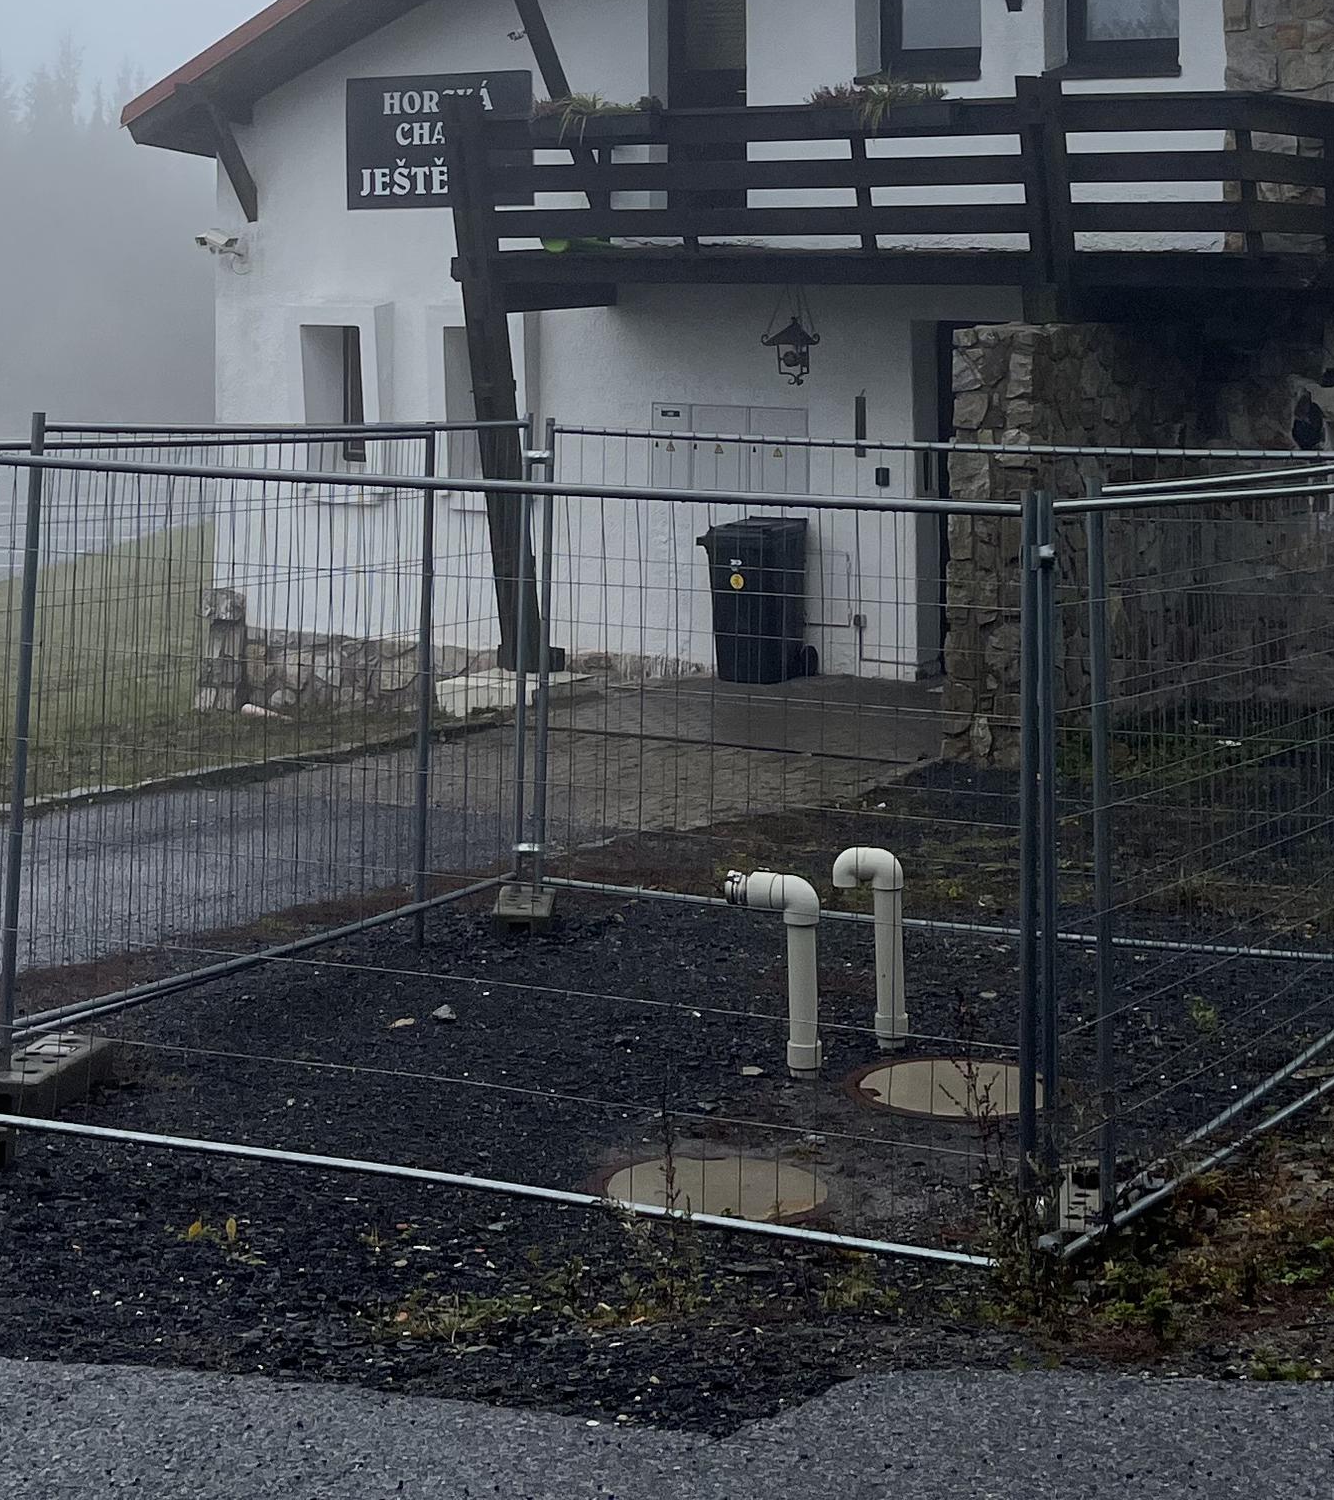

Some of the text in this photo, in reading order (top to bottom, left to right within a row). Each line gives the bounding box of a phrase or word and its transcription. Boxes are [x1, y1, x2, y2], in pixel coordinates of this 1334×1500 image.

[382, 80, 493, 114] HORÁ
[395, 121, 445, 146] CHA
[361, 157, 449, 197] JEŠTĚ
